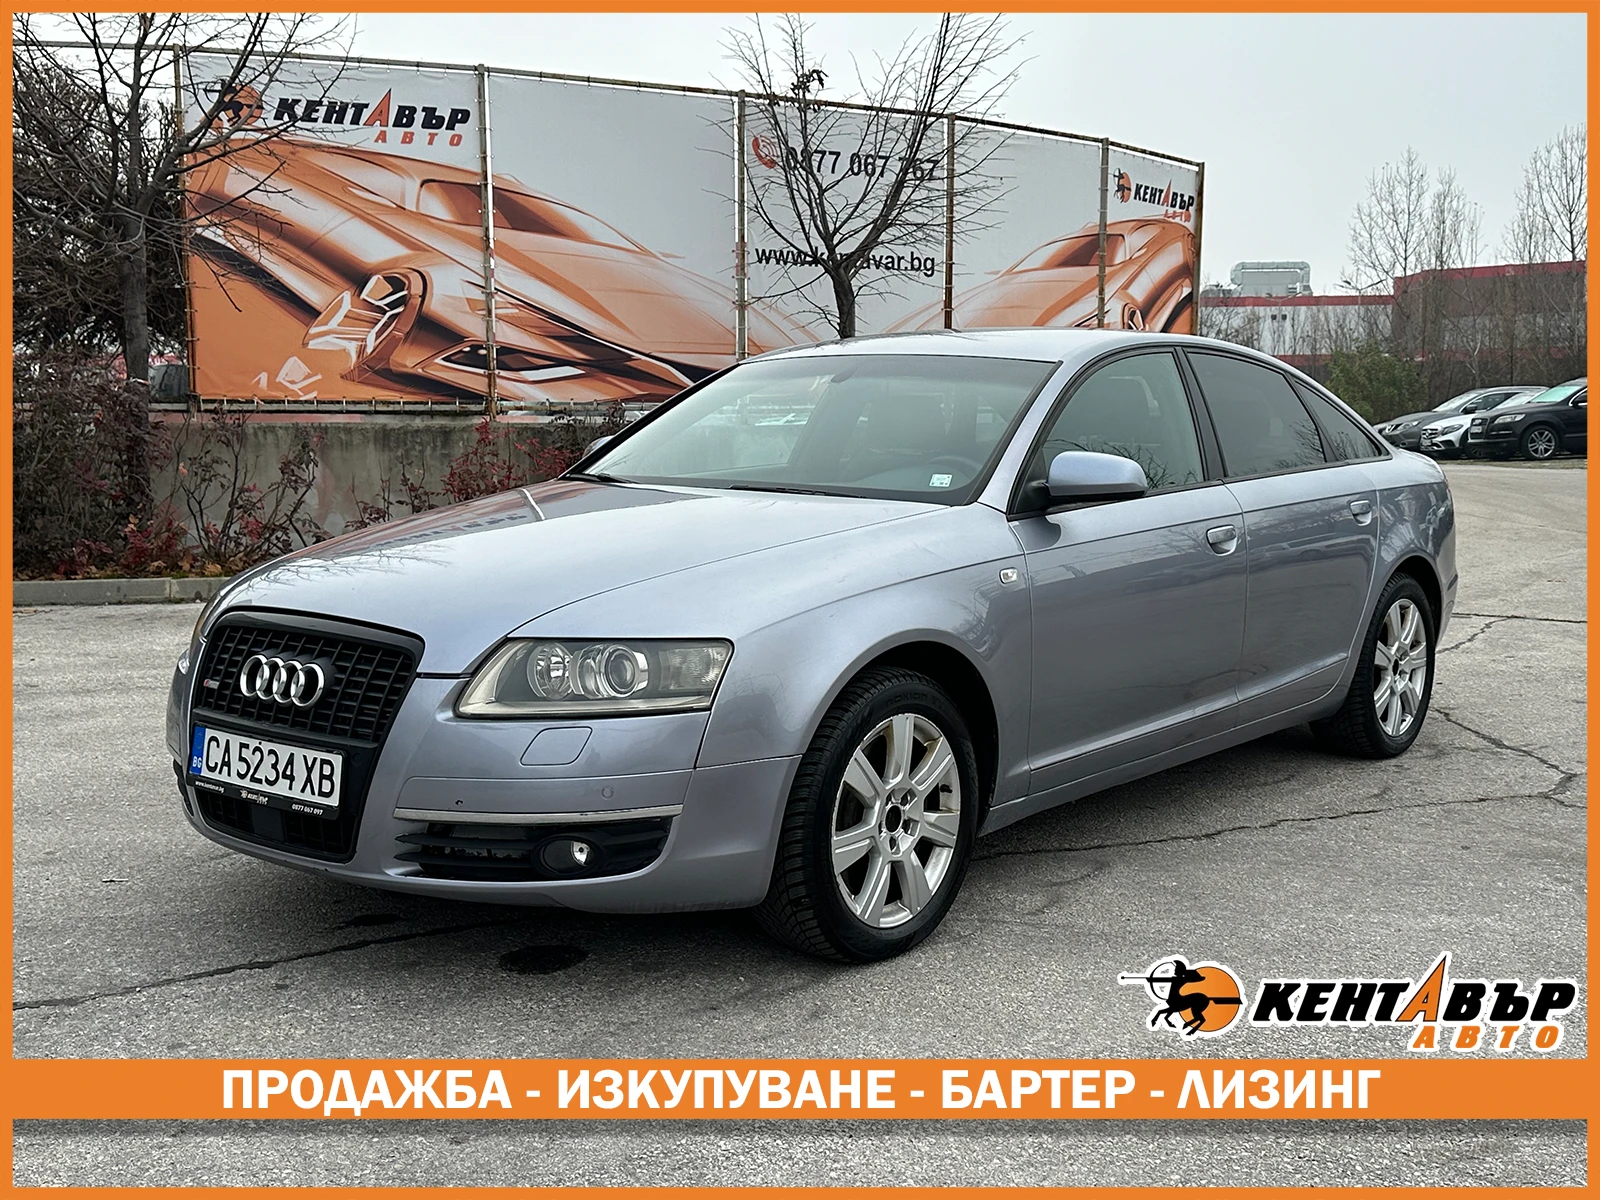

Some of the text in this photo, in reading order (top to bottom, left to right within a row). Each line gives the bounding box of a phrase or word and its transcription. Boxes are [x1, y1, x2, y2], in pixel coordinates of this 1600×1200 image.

[273, 87, 471, 131] КЕНТАВЪР
[374, 129, 463, 147] АВТО
[850, 153, 890, 178] 067
[1133, 179, 1195, 211] КЕНТАВЪР
[755, 246, 935, 277] www.kavar.bg
[192, 756, 203, 768] BG
[236, 741, 296, 791] 5234
